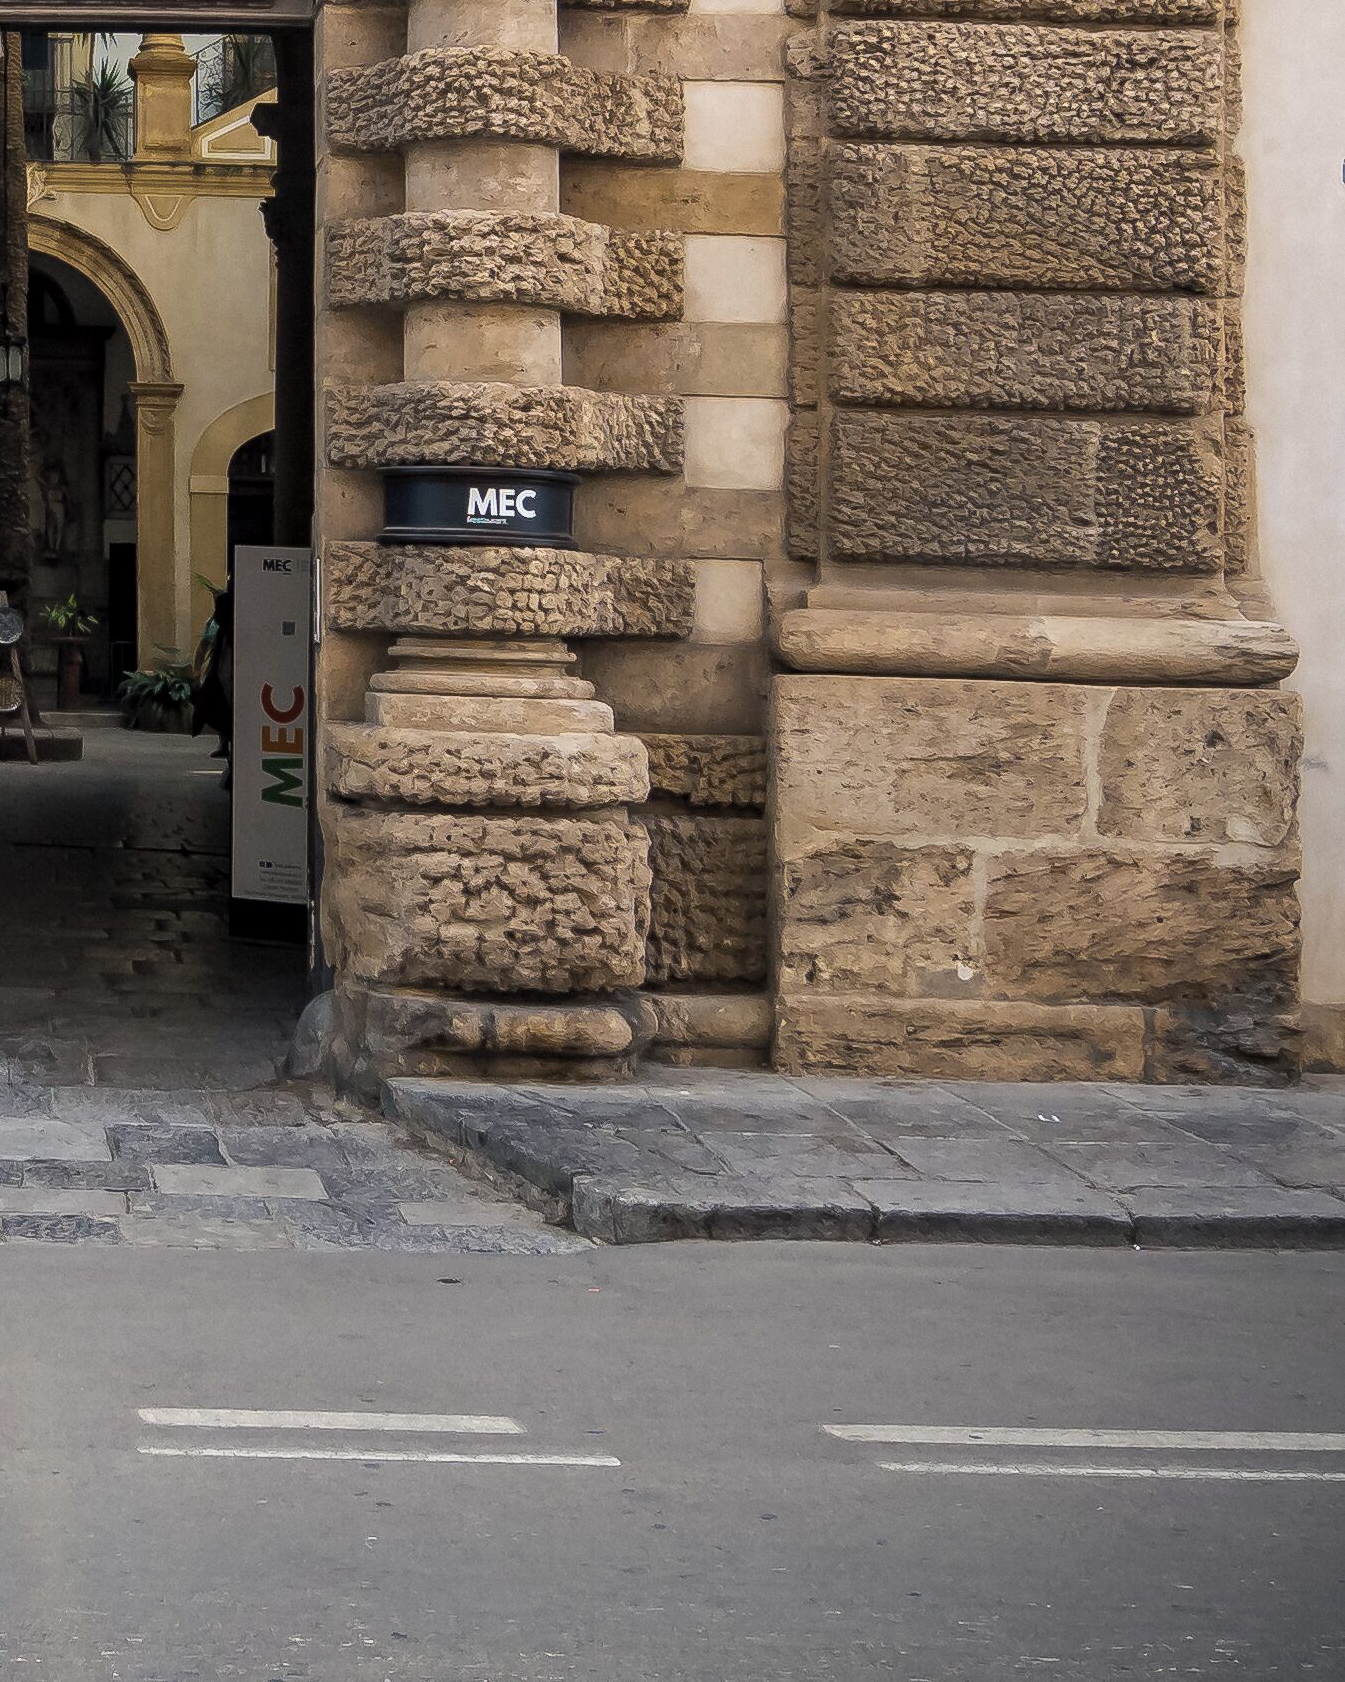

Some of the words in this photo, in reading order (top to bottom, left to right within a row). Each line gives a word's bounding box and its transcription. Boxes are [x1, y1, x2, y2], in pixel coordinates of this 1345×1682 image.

[466, 487, 538, 520] MEC
[262, 558, 294, 573] MEC
[261, 682, 305, 808] MEC
